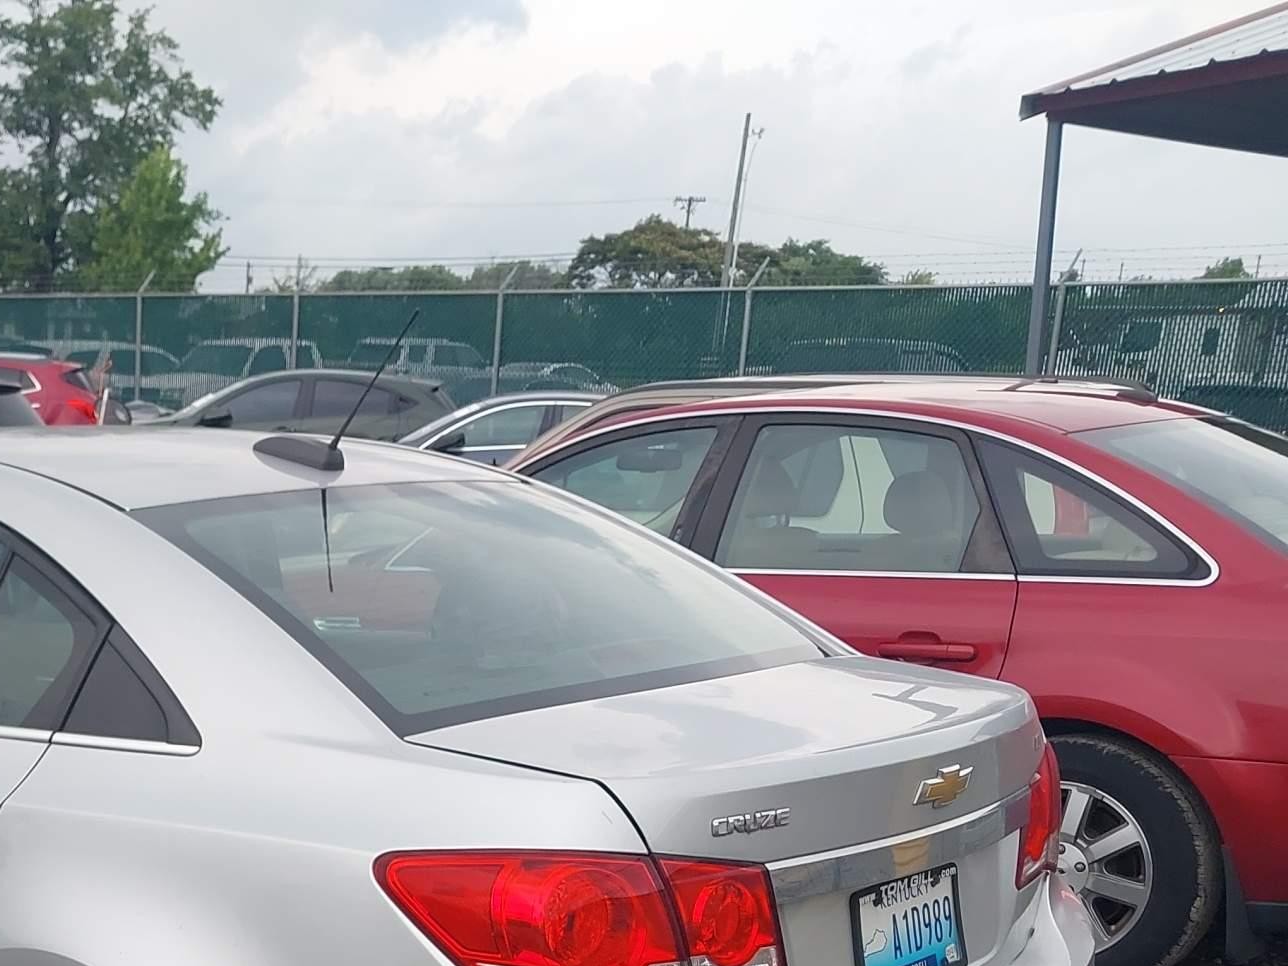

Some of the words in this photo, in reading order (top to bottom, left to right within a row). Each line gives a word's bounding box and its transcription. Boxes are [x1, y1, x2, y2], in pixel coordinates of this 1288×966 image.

[712, 807, 791, 837] CRUZE
[879, 878, 908, 898] TOM
[910, 870, 933, 886] GILL
[892, 896, 952, 960] A1D989
